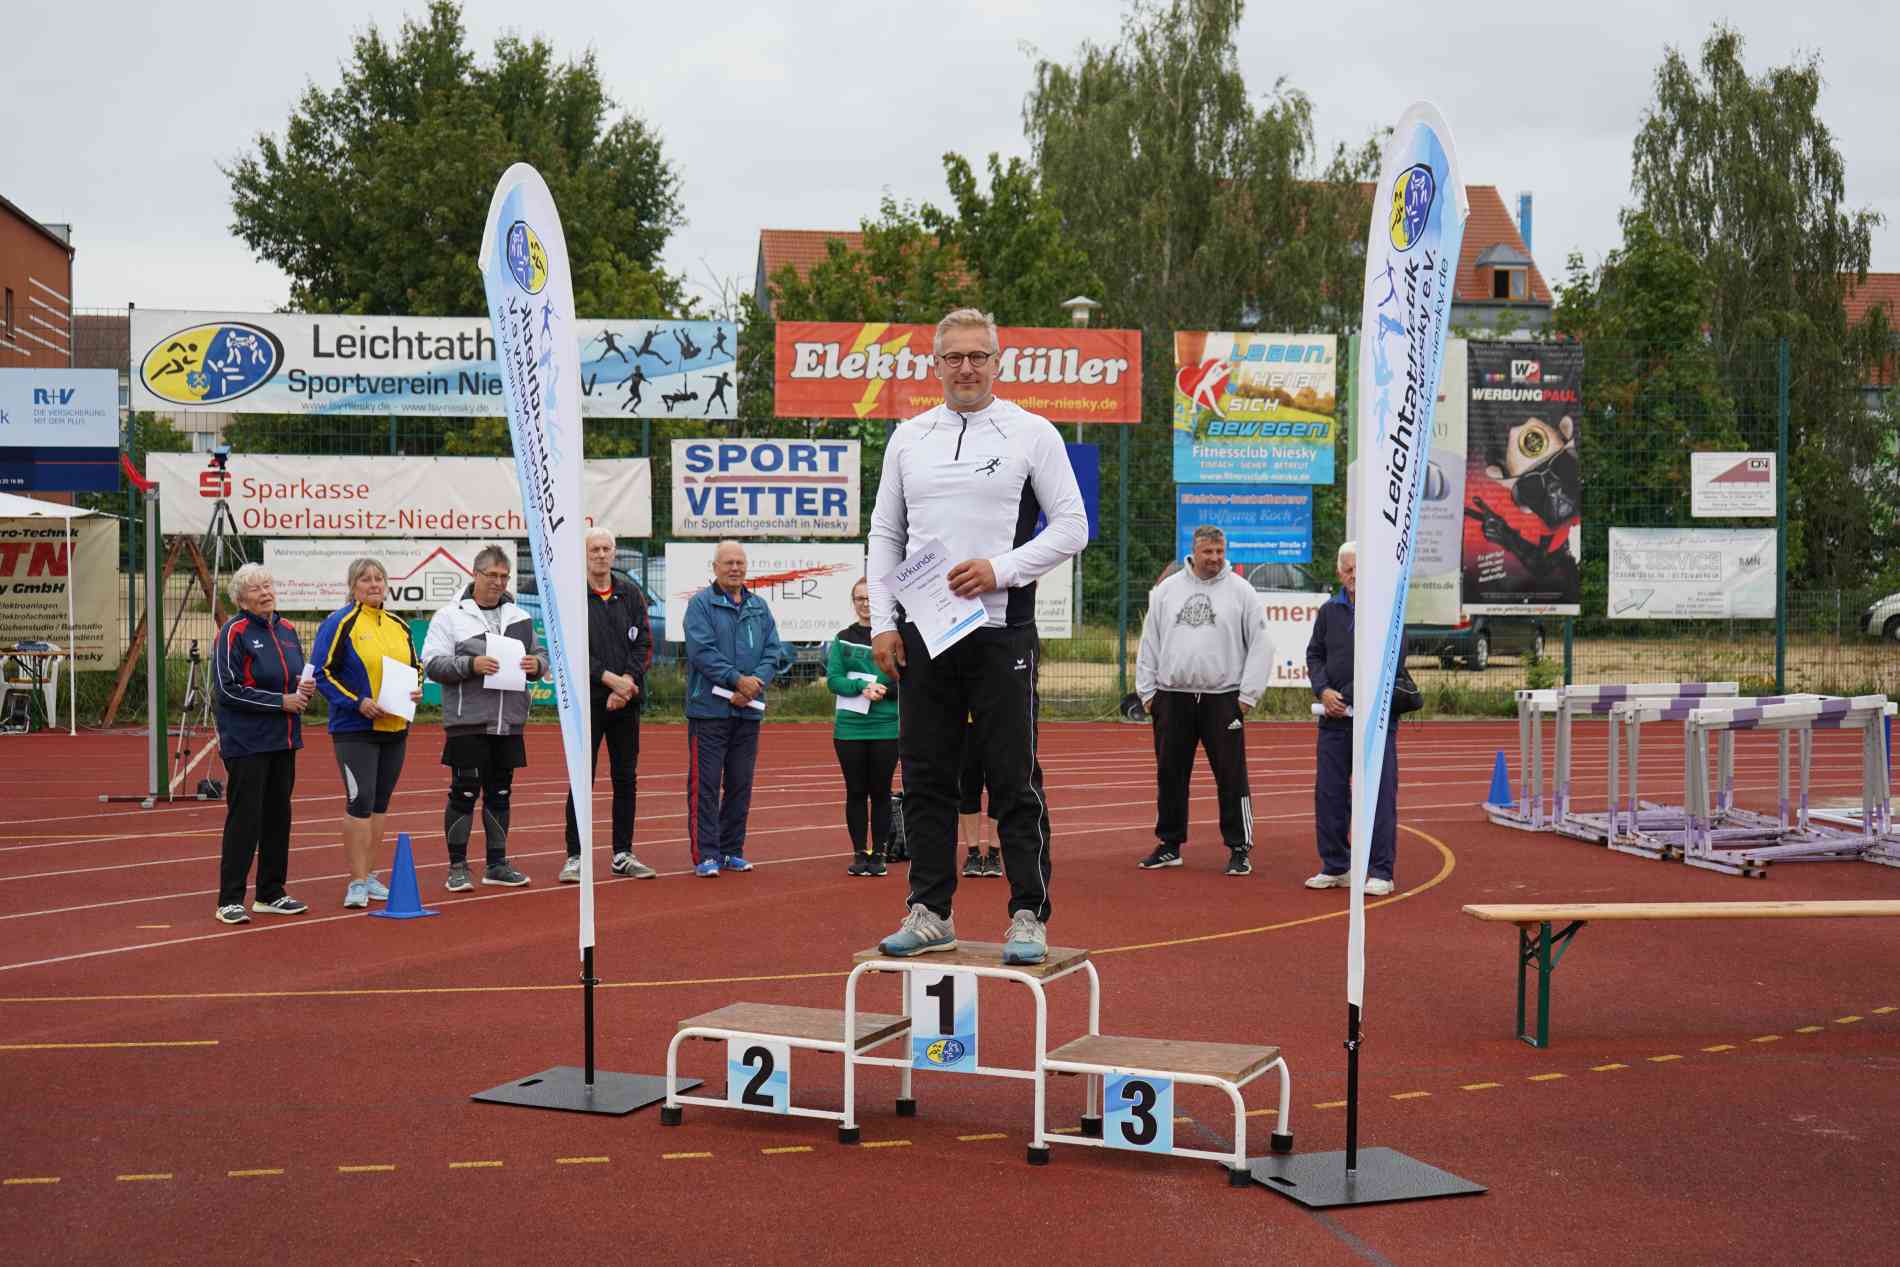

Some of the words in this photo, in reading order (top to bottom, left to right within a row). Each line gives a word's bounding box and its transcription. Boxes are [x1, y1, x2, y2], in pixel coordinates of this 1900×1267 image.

[313, 324, 496, 361] Leichtath
[1417, 303, 1431, 400] Niesky
[790, 342, 943, 380] Elektr
[33, 387, 75, 405] R+V
[288, 368, 449, 399] Sportverein
[458, 371, 503, 395] Nie
[581, 373, 603, 397] V.
[1383, 258, 1420, 529] Leichtathletik
[685, 444, 849, 473] SPORT
[1192, 446, 1268, 458] Fitnessclub
[1272, 447, 1316, 461] Niesky
[241, 478, 369, 504] Sparkasse
[685, 486, 848, 517] VETTER
[684, 518, 698, 529] Ihr
[801, 518, 810, 528] in
[813, 519, 849, 531] Niesky
[896, 552, 936, 582] Urkunde
[12, 583, 66, 594] GmbH
[926, 975, 957, 1035] 1
[741, 1046, 774, 1107] 2
[1121, 1081, 1158, 1146] 3
